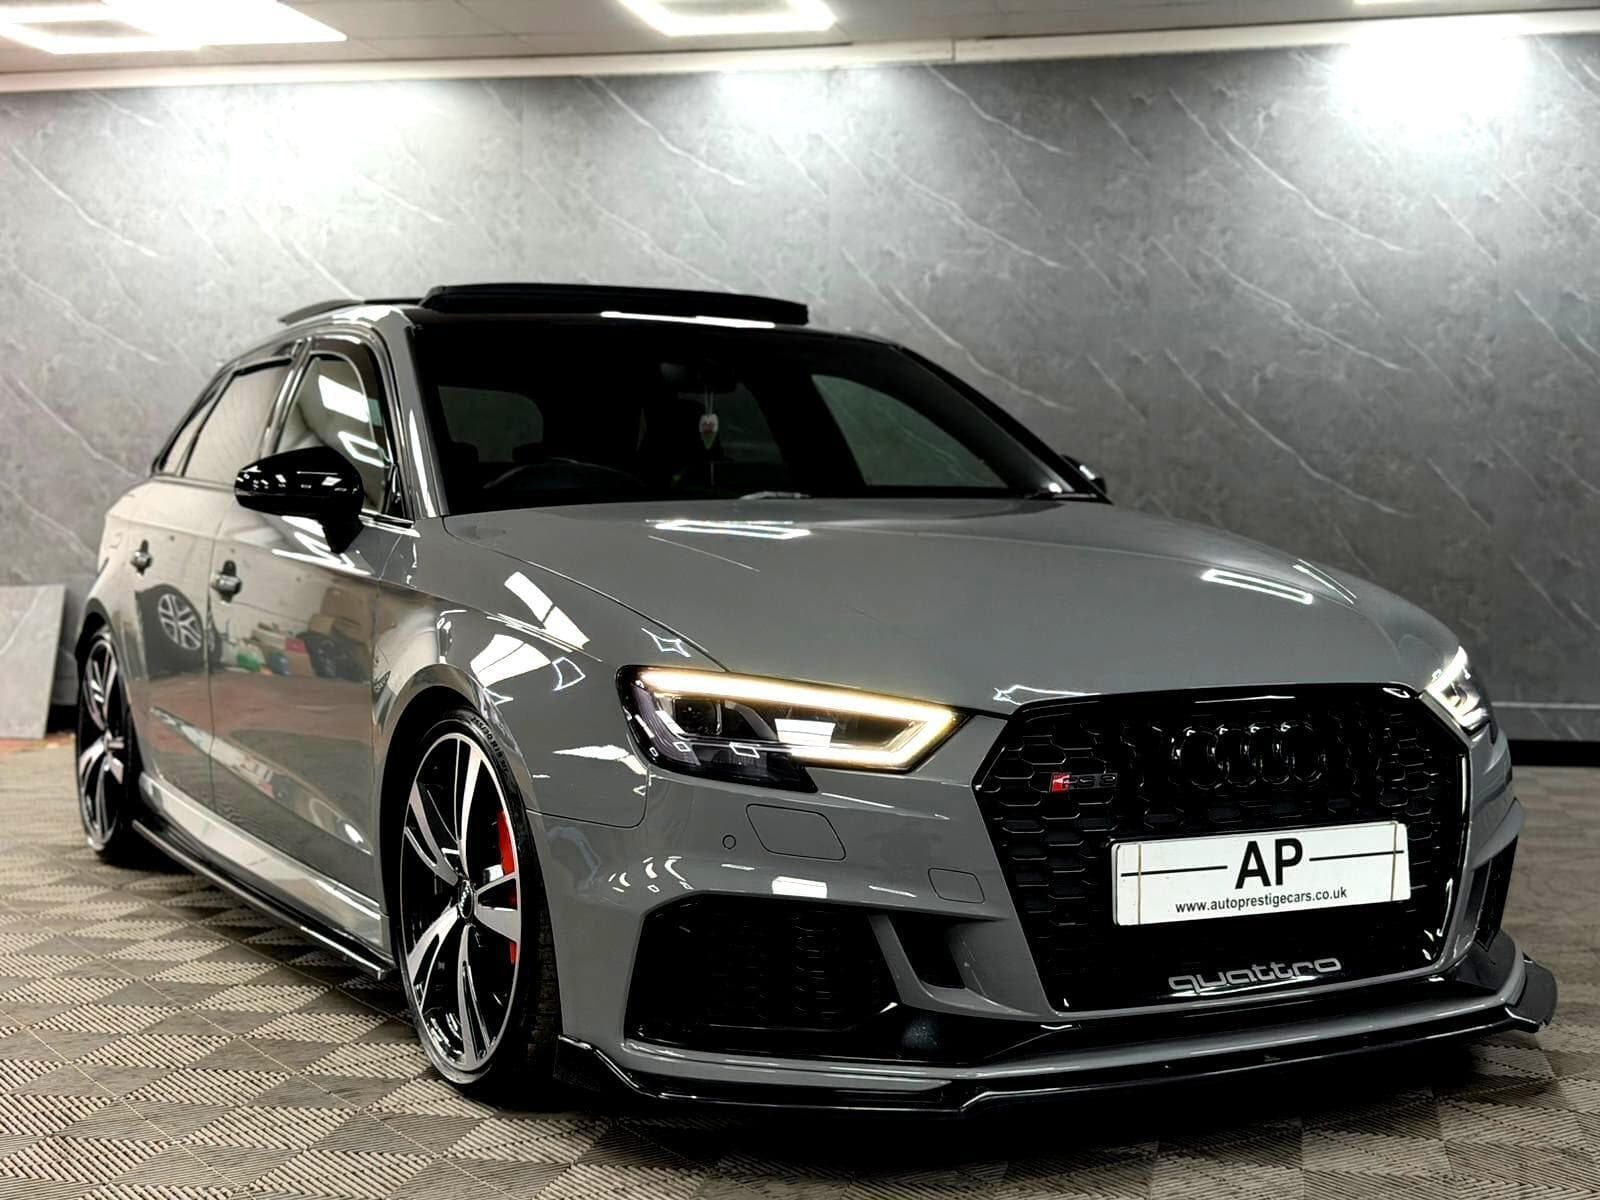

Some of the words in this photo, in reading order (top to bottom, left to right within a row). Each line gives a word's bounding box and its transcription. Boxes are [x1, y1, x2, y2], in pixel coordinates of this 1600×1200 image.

[1235, 837, 1304, 890] AP
[1175, 886, 1348, 913] www.autoprestigecars.co.uk
[1168, 957, 1342, 993] quattro
